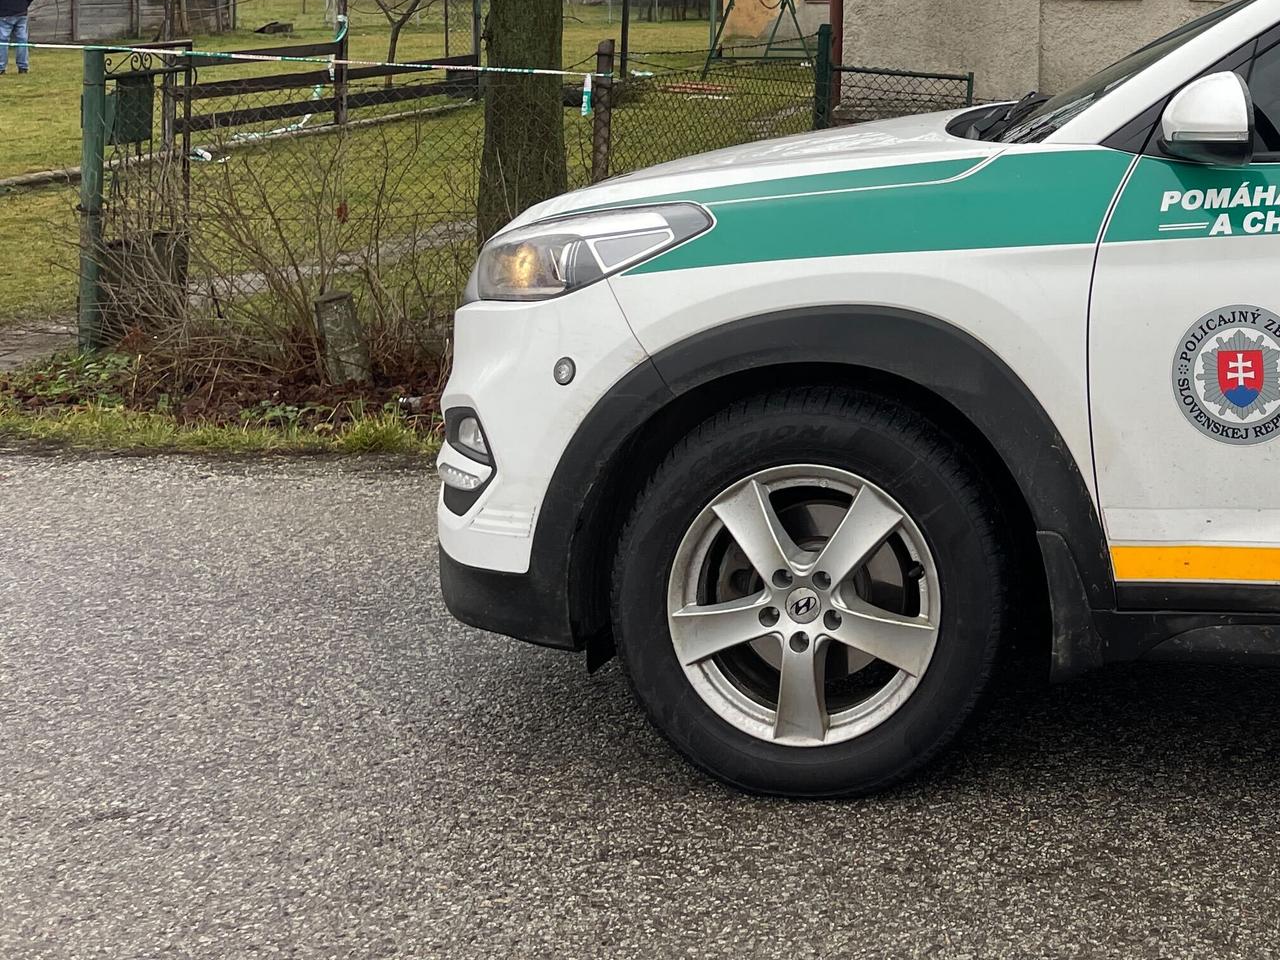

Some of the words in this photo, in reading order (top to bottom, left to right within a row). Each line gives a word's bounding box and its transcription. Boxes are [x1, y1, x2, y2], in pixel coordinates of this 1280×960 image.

[1208, 213, 1233, 236] A
[1179, 308, 1262, 363] POLICAJNÝ
[1177, 377, 1249, 440] SLOVENSKEJ
